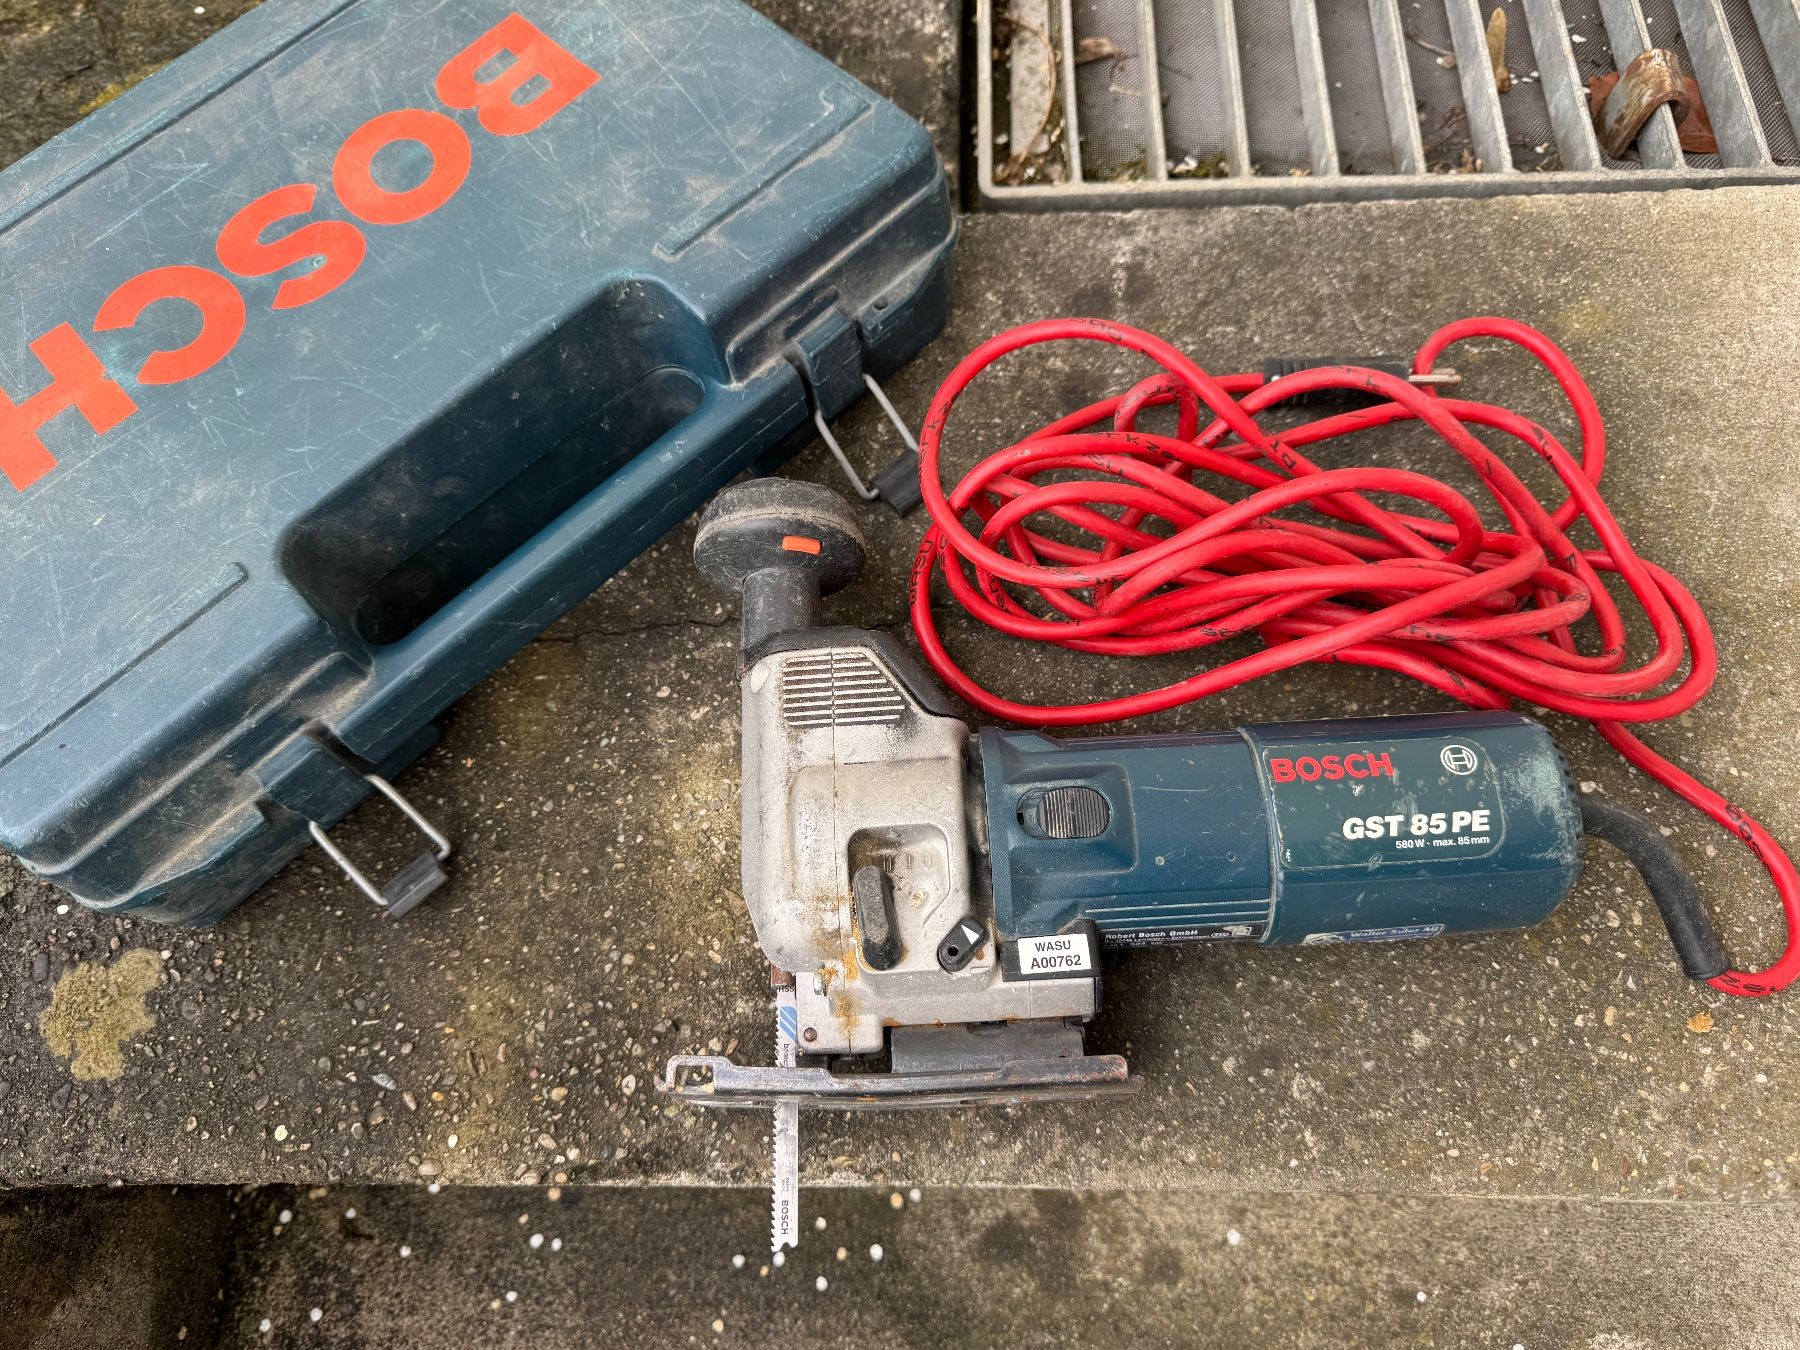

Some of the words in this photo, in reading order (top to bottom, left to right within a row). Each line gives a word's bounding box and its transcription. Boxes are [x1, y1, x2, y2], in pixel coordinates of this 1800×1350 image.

[0, 12, 601, 492] BOSCH
[1270, 752, 1394, 783] BOSCH
[1342, 814, 1404, 840] GST
[1410, 812, 1447, 836] 85
[1452, 809, 1490, 833] PE
[1432, 838, 1456, 847] max.
[1034, 939, 1072, 953] WASU
[1105, 932, 1136, 940] Robert
[1169, 929, 1198, 937] GmbH
[1030, 954, 1082, 970] A00762
[780, 1200, 789, 1235] BOSCH
